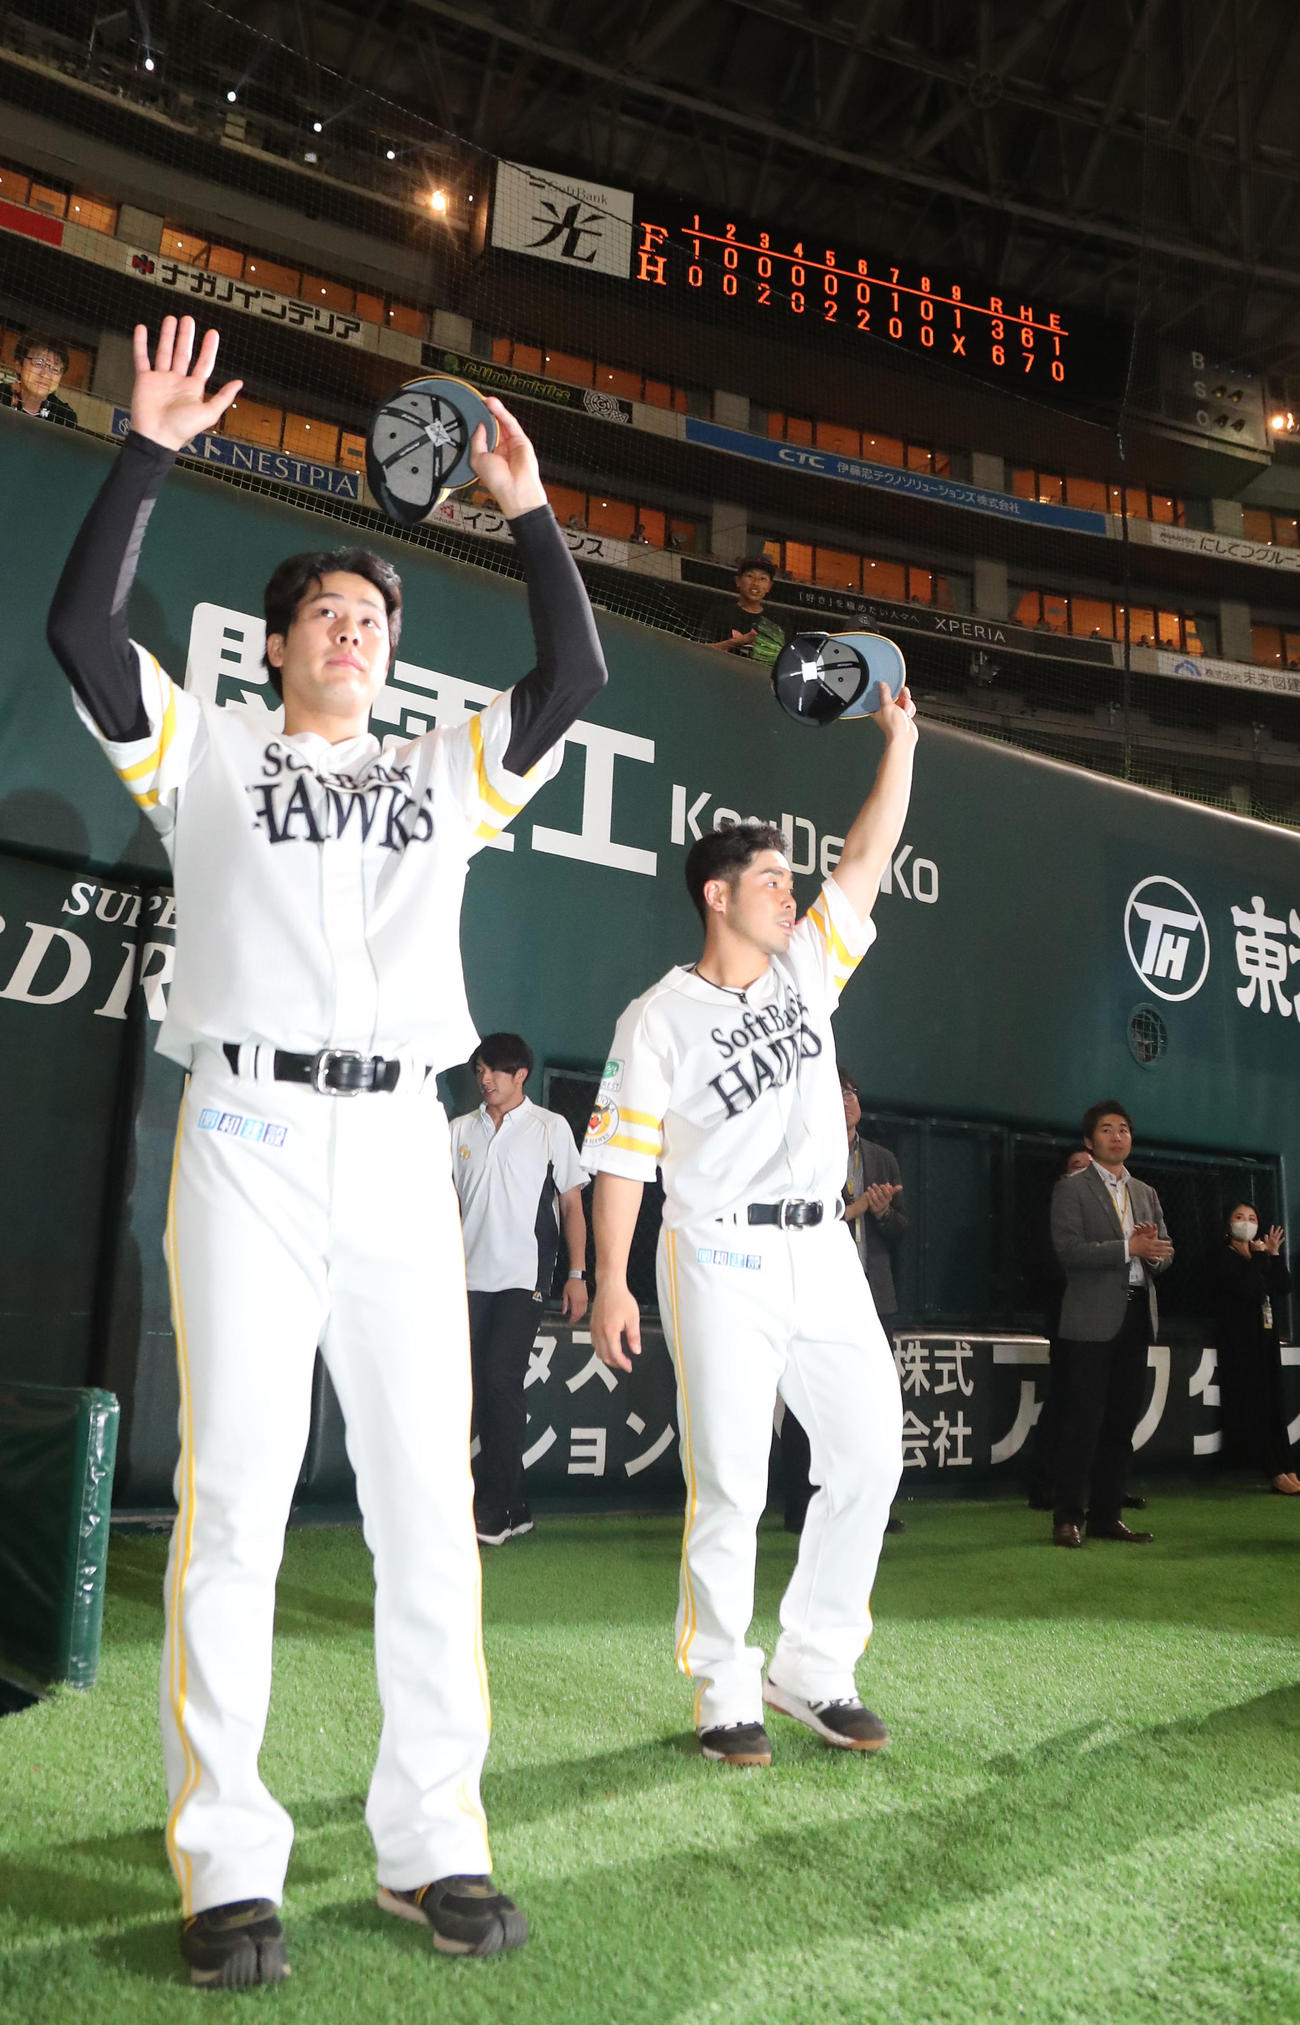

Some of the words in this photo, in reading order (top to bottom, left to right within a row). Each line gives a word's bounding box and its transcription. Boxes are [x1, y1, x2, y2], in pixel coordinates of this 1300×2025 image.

[525, 200, 606, 263] 光
[640, 222, 669, 252] F
[693, 239, 700, 260] 1
[724, 248, 738, 269] 0
[758, 257, 772, 278] 0
[791, 265, 805, 286] 0
[824, 274, 838, 295] 0
[857, 283, 870, 304] 0
[891, 292, 899, 312] 1
[920, 300, 933, 321] 0
[954, 309, 961, 329] 1
[991, 319, 1004, 340] 3
[1021, 327, 1034, 348] 6
[1053, 336, 1060, 356] 1
[693, 215, 699, 230] 1
[726, 224, 736, 240] 2
[760, 233, 769, 249] 3
[793, 243, 803, 257] 4
[826, 250, 835, 266] 5
[858, 259, 867, 275] 6
[890, 267, 899, 283] 7
[921, 276, 930, 292] 8
[952, 285, 961, 301] 9
[990, 297, 1003, 313] R
[1020, 305, 1033, 322] H
[1050, 313, 1061, 330] E
[162, 264, 361, 340] ナガノインテリア
[637, 251, 667, 286] H
[688, 265, 702, 287] 0
[723, 274, 737, 296] 0
[758, 283, 771, 305] 2
[791, 292, 805, 313] 0
[824, 300, 838, 322] 2
[857, 309, 870, 331] 2
[889, 317, 902, 338] 0
[920, 325, 934, 347] 0
[952, 333, 966, 356] X
[992, 345, 1005, 366] 6
[1022, 352, 1035, 373] 7
[1052, 361, 1064, 382] 0
[1192, 352, 1204, 369] B
[1194, 381, 1206, 398] S
[232, 445, 354, 496] NESTPIA
[779, 448, 825, 470] CTC
[1200, 536, 1300, 568] にしてつグルー
[933, 615, 1006, 644] XPERIA
[1231, 896, 1300, 1022] 東
[894, 1341, 973, 1397] 株式
[902, 1411, 972, 1468] 会社
